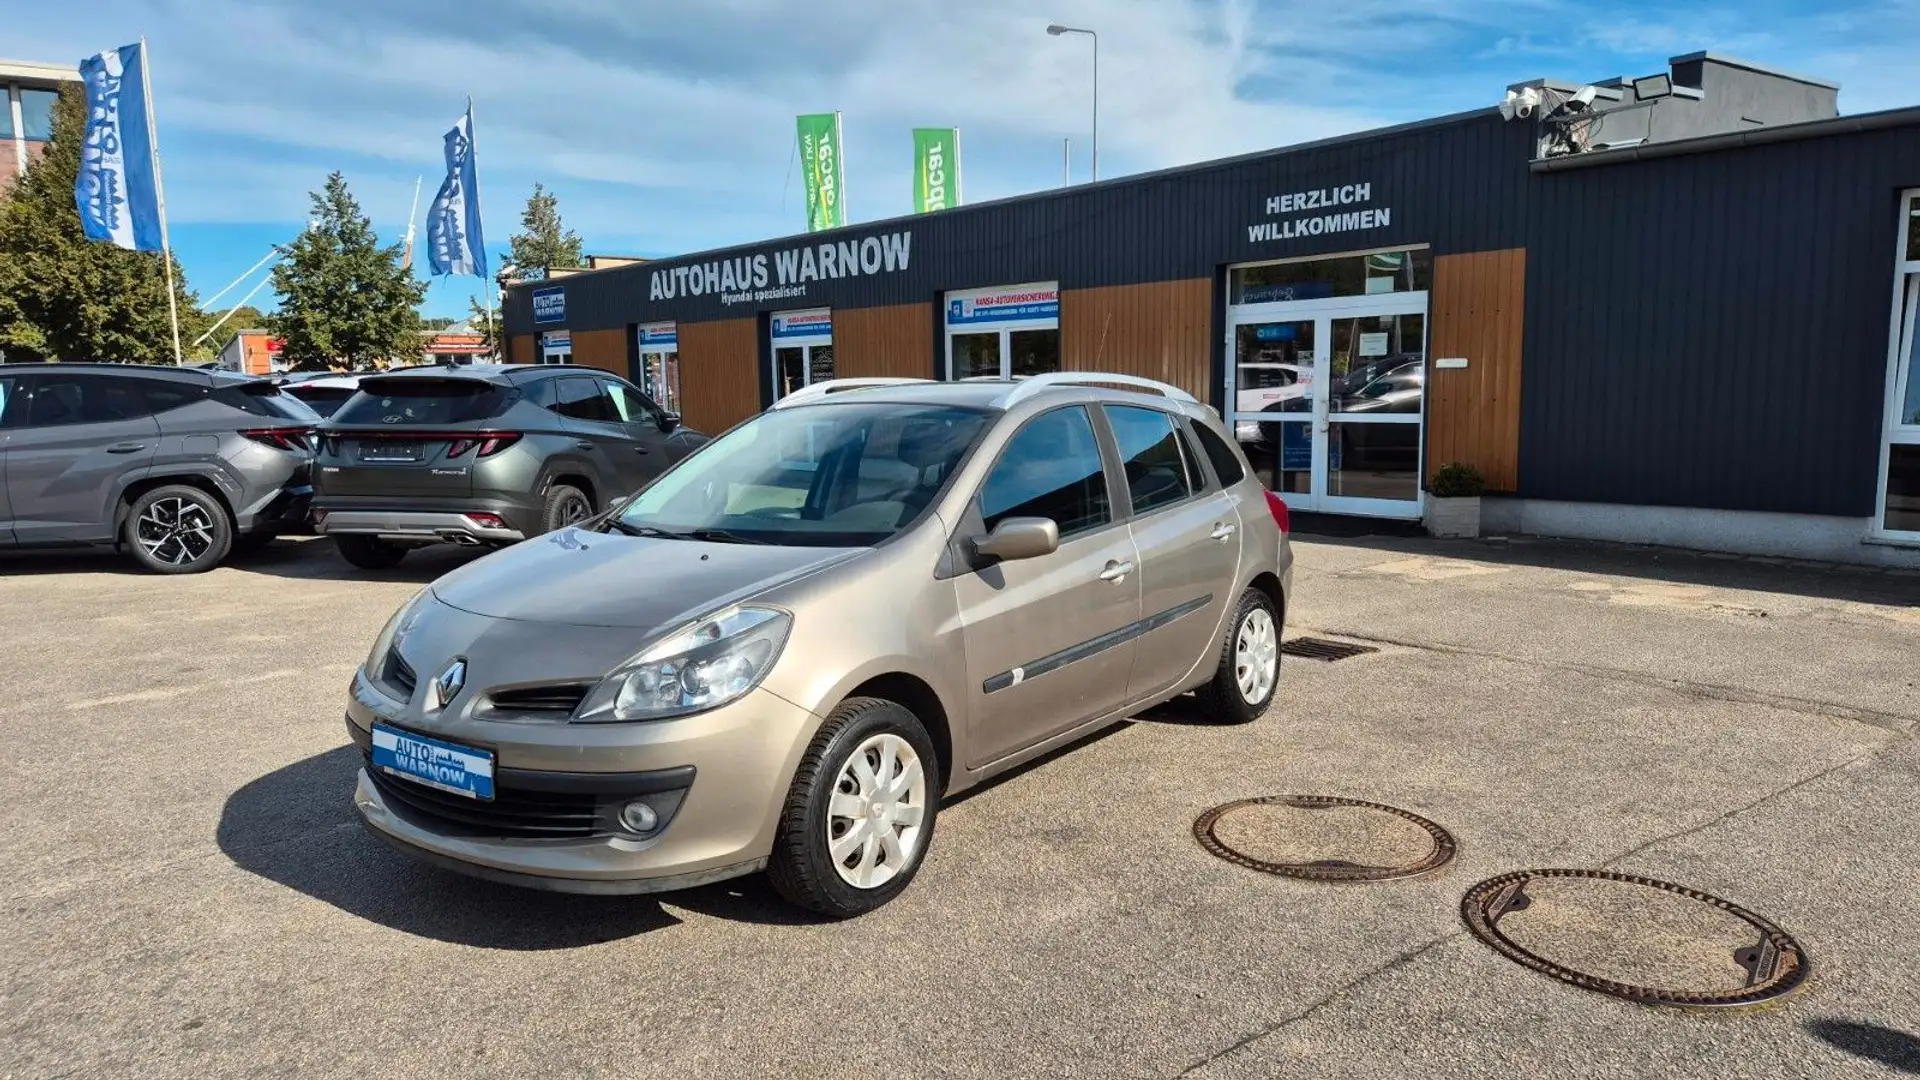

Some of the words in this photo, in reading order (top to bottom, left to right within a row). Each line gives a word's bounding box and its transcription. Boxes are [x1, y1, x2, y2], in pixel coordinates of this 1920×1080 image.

[1266, 182, 1371, 215] HERZLICH
[1248, 207, 1391, 243] WILLKOMMEN
[650, 254, 768, 301] AUTOHAUS
[775, 231, 912, 285] WARNOW
[721, 290, 753, 306] Hyundai
[754, 285, 807, 302] spezialisiert
[395, 738, 430, 761] AUTO
[395, 753, 465, 785] WARNOW
